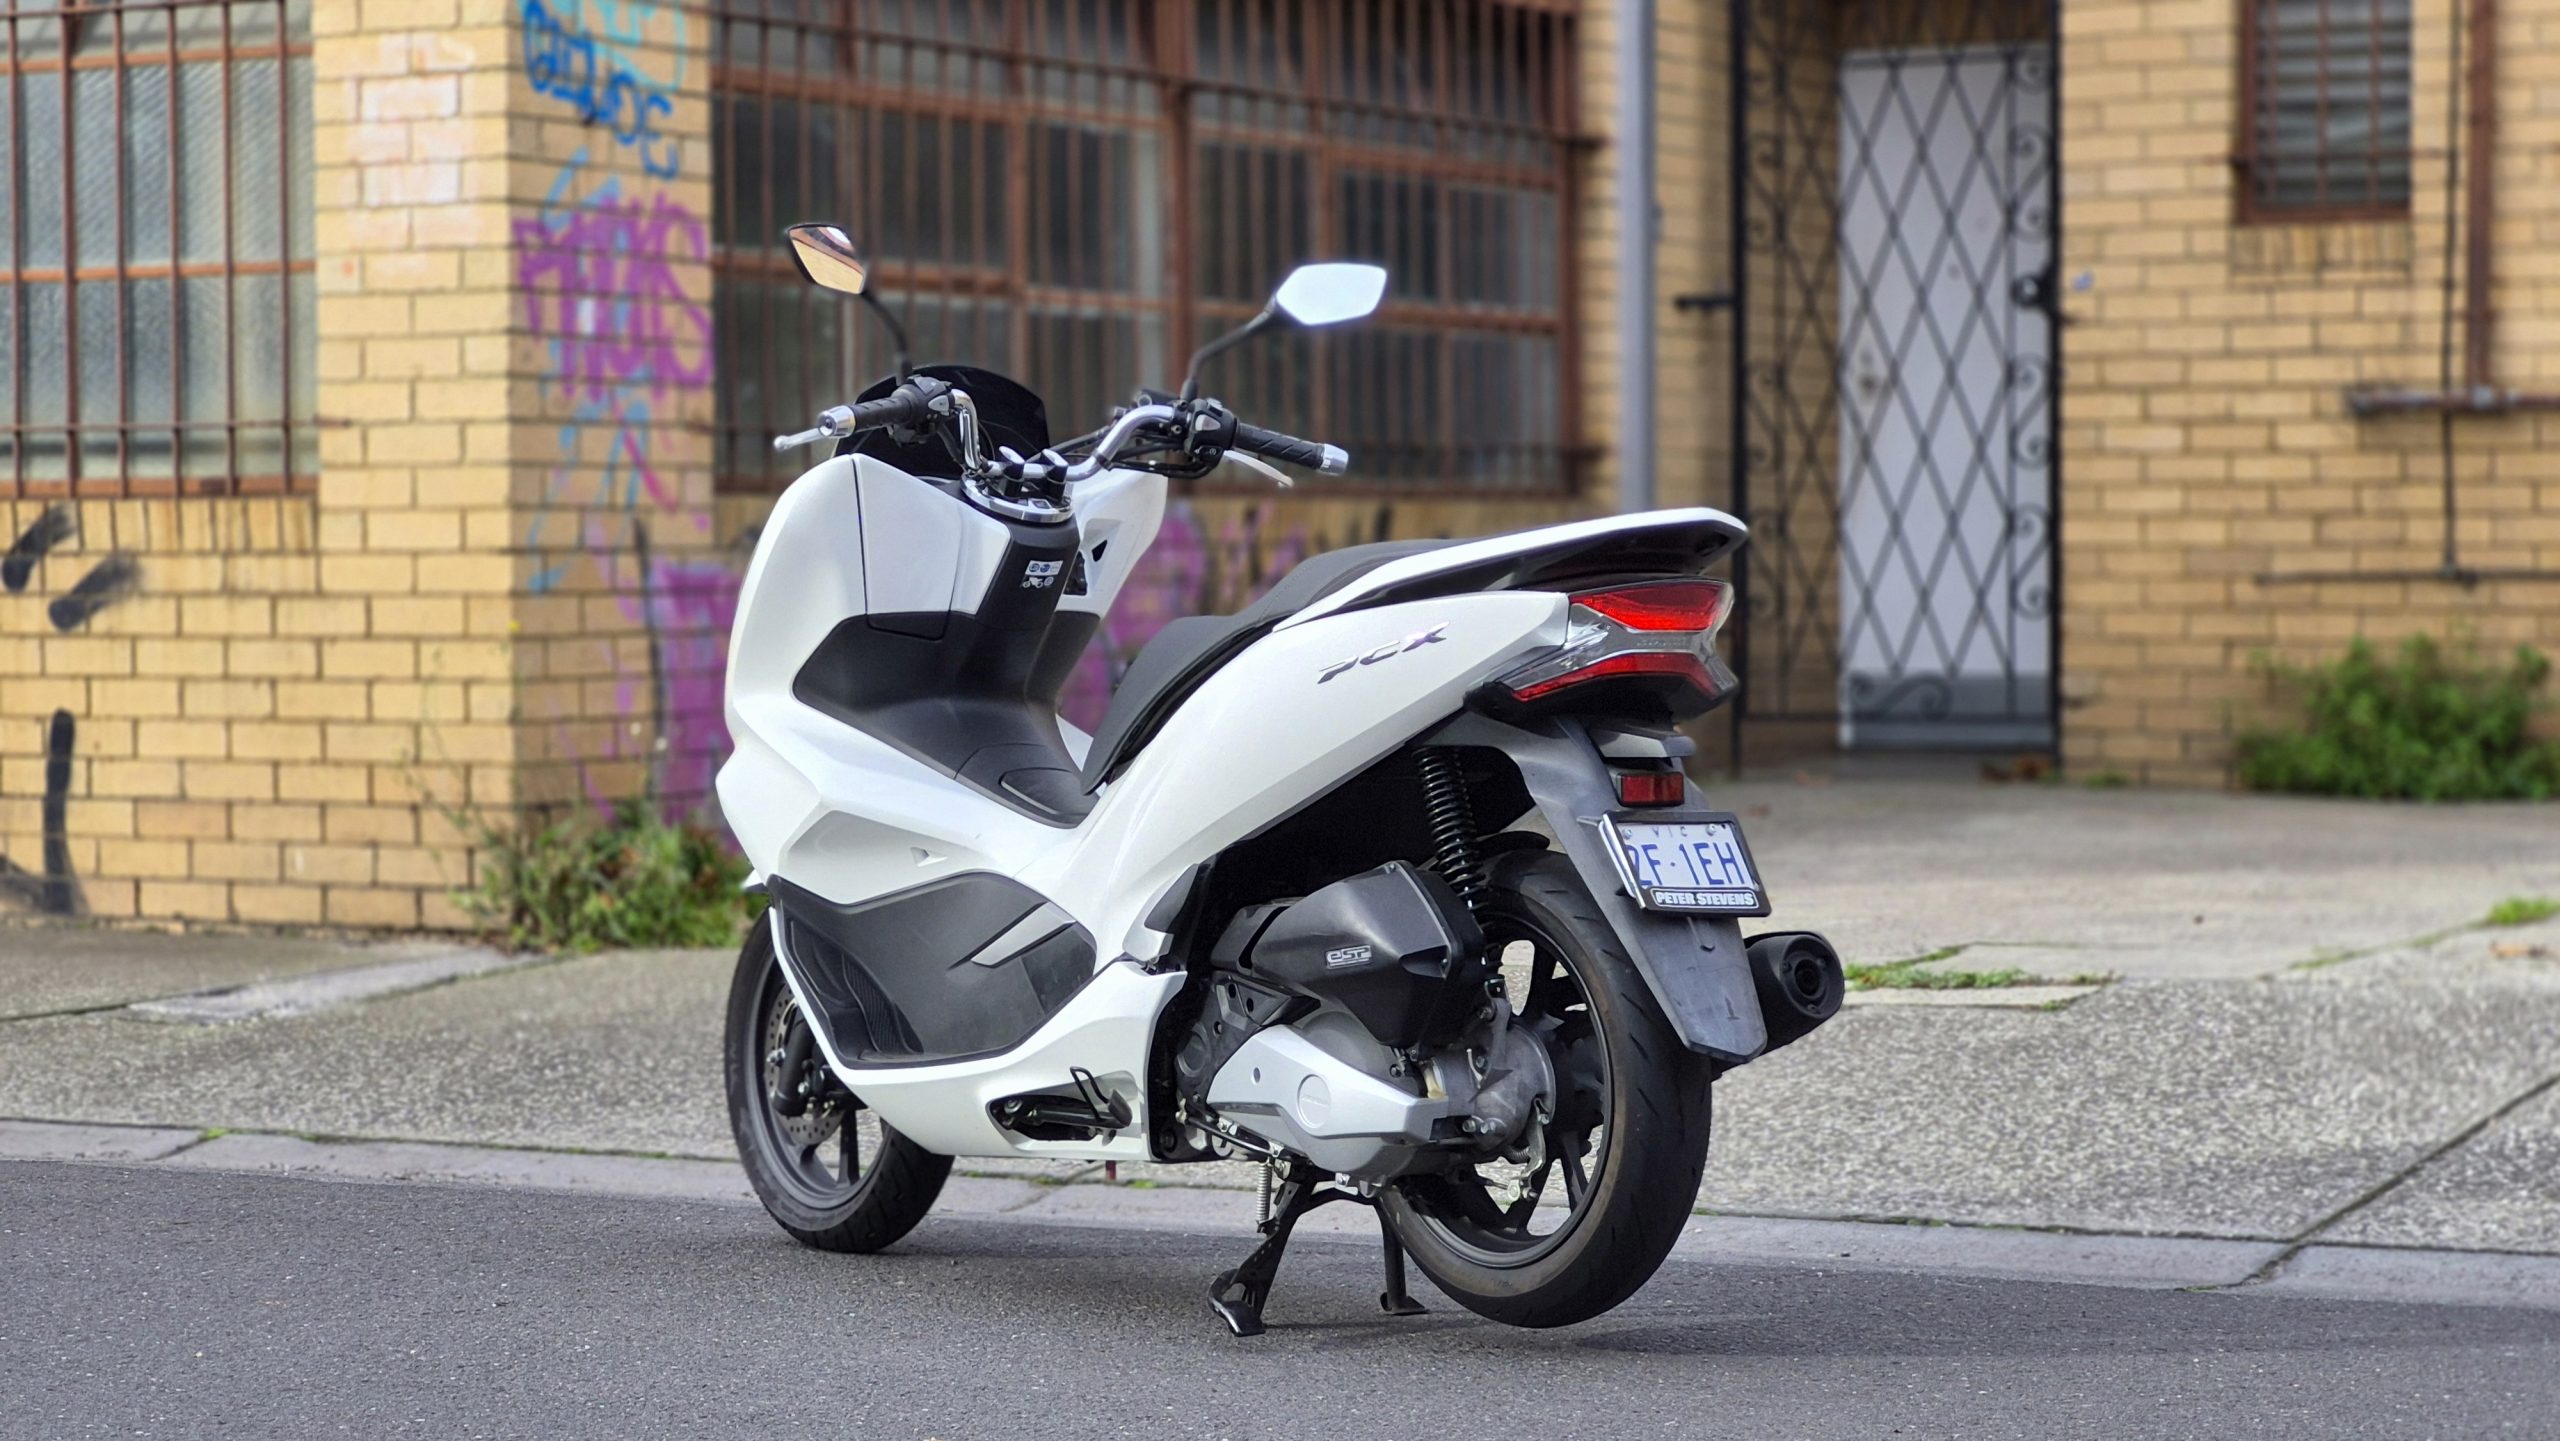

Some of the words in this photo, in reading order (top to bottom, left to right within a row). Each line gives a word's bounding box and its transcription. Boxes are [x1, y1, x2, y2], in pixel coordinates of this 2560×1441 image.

[1317, 620, 1451, 684] PCX
[1655, 891, 1696, 905] PETER
[1696, 892, 1754, 905] STEVENS
